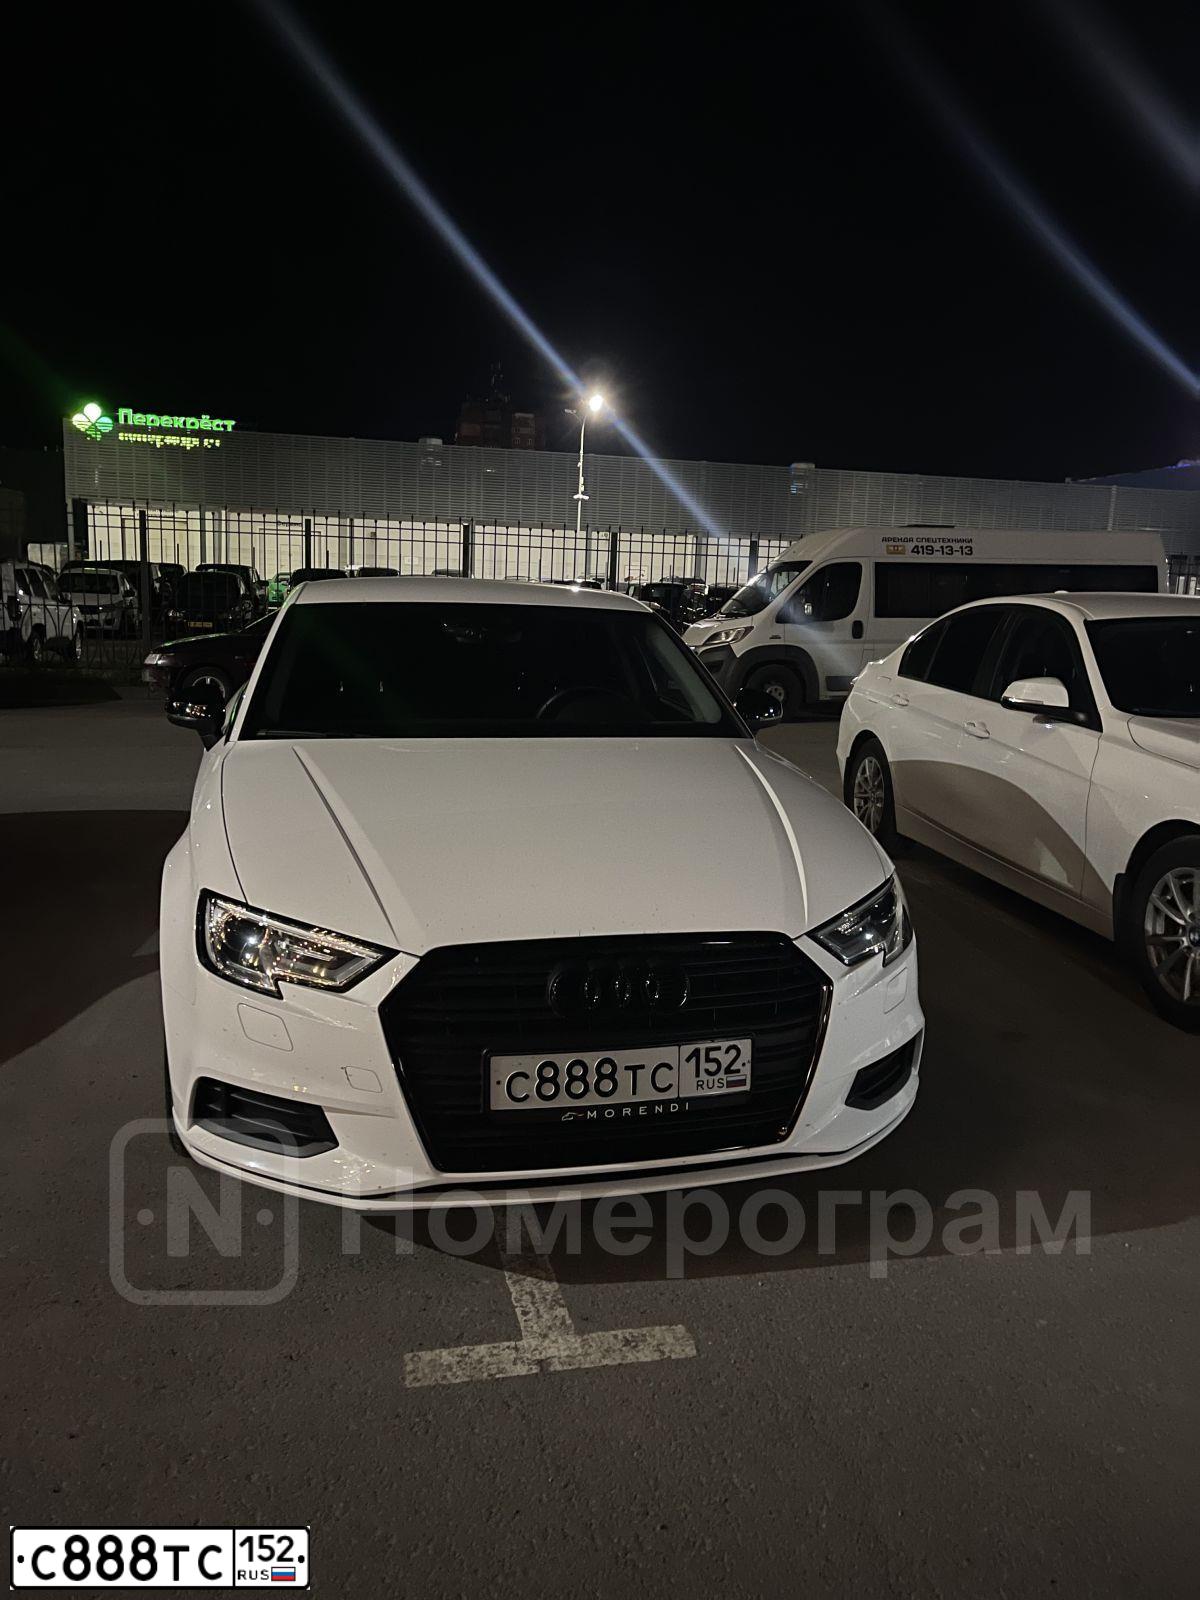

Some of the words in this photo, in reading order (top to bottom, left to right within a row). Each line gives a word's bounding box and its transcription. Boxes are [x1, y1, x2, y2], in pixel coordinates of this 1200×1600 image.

[915, 536, 973, 544] СПЕЦТЕХНИКИ
[911, 545, 973, 556] 419-13-13
[685, 1044, 742, 1077] 152
[696, 1078, 725, 1091] RUS
[586, 1102, 690, 1119] MORENDI
